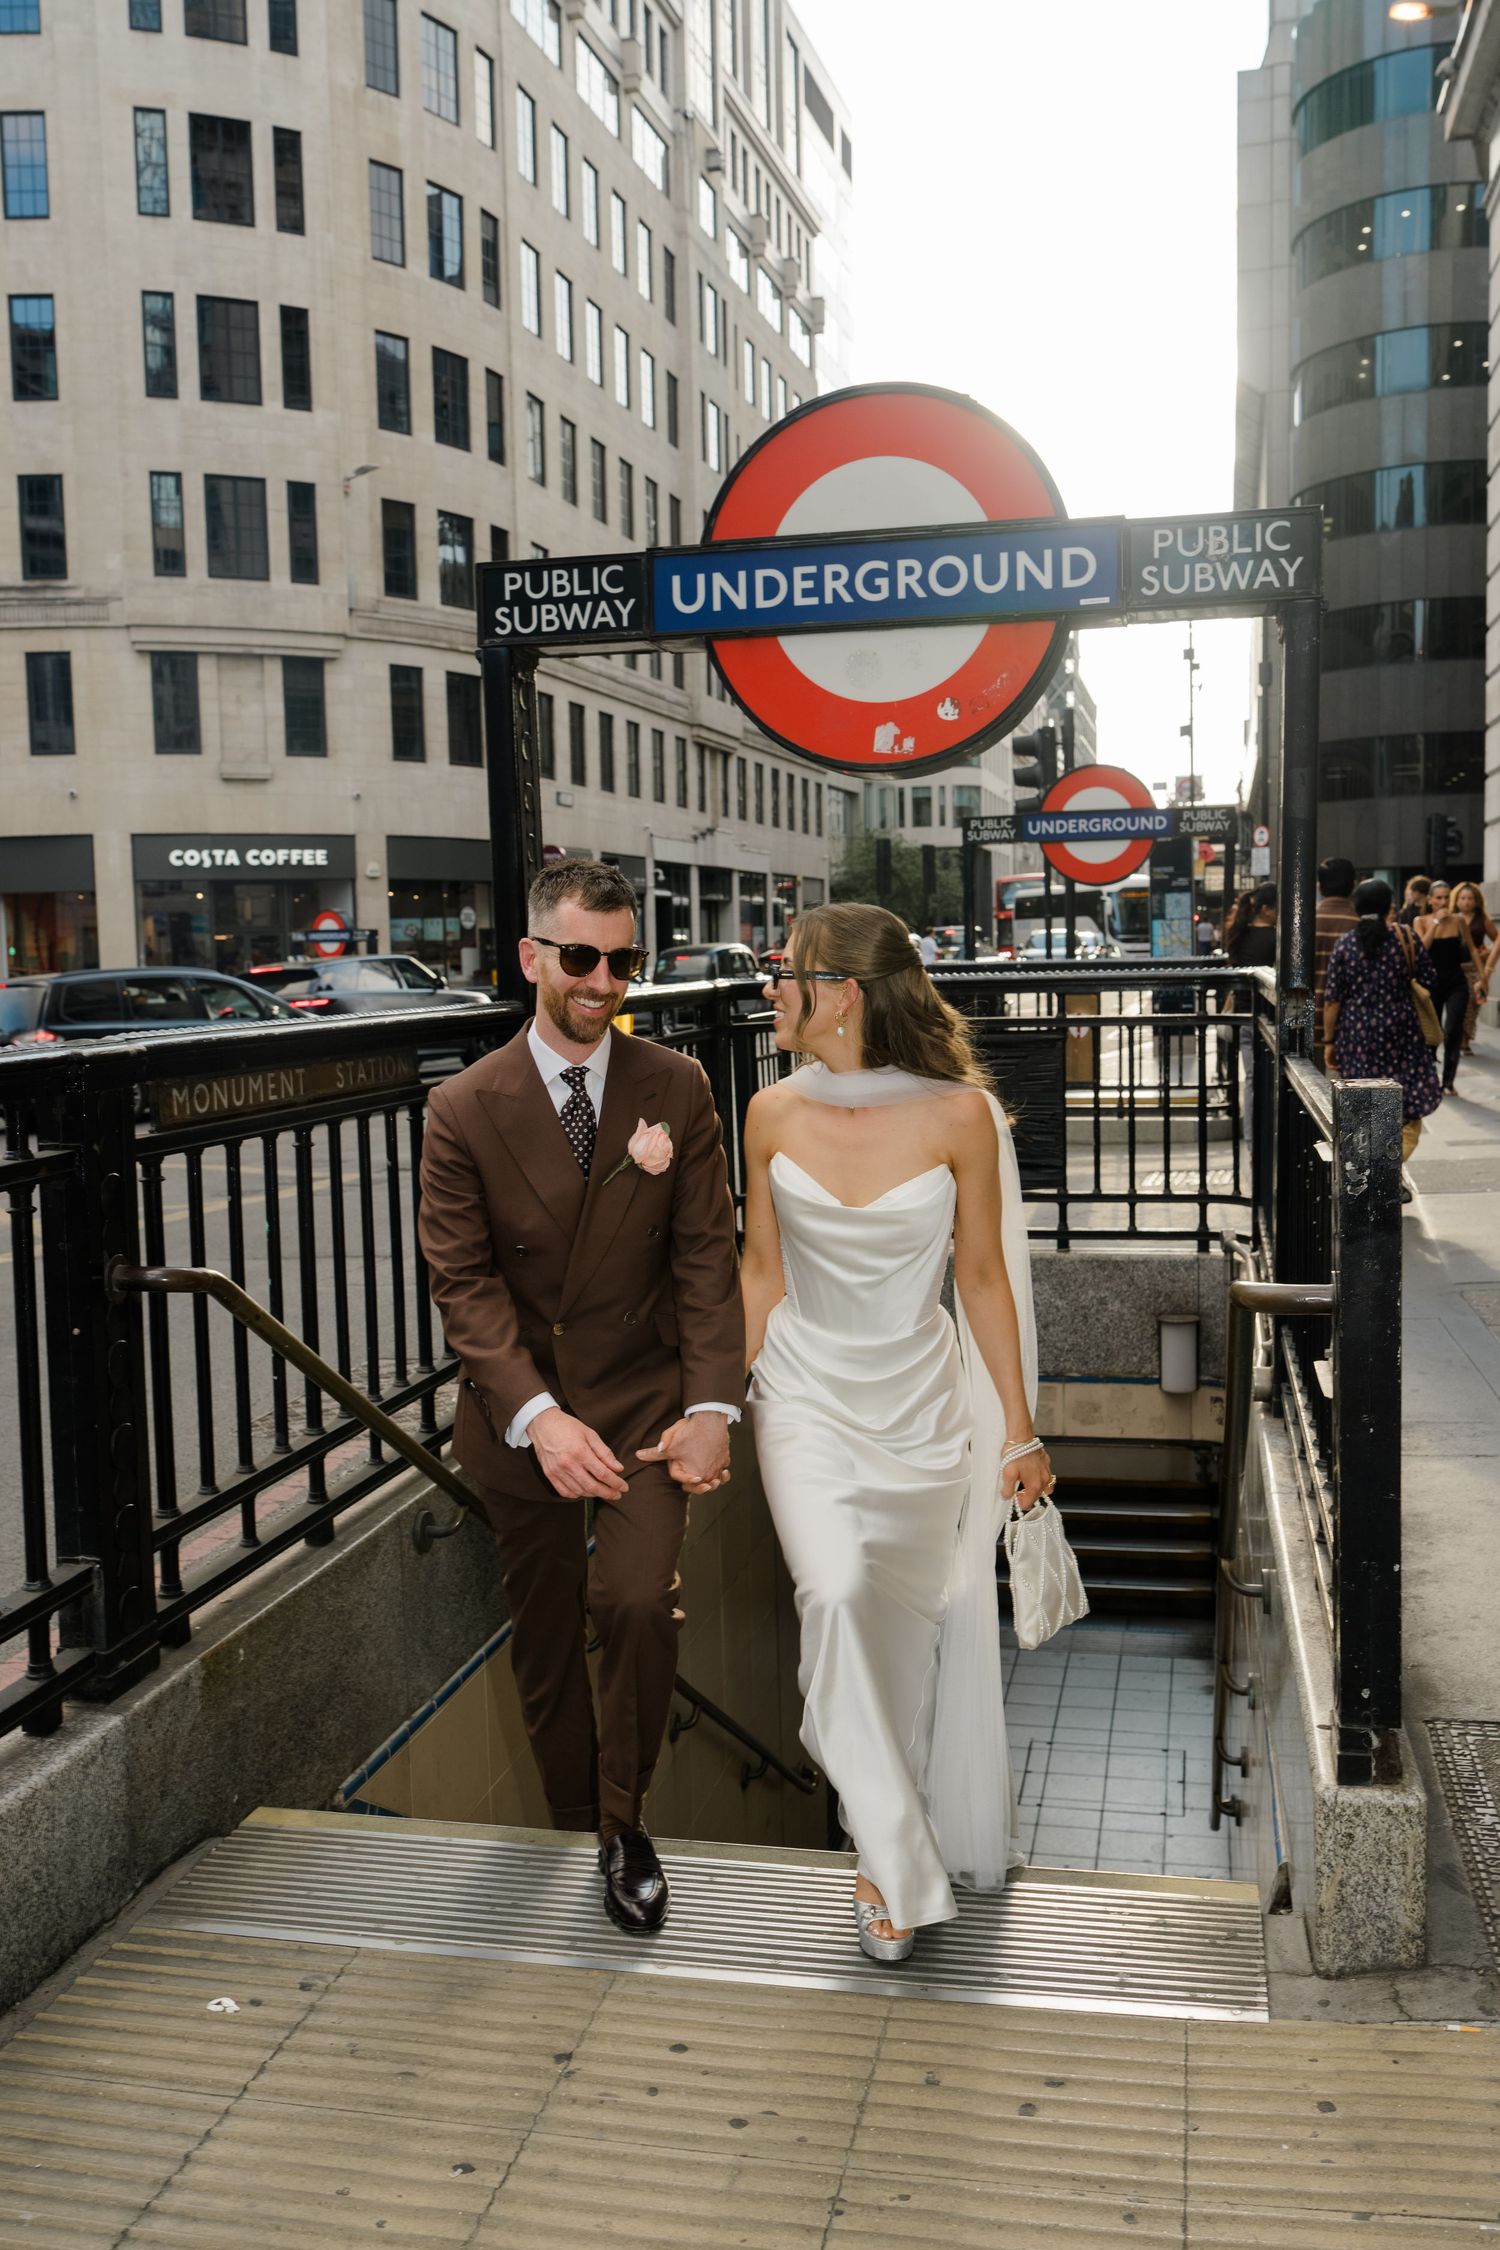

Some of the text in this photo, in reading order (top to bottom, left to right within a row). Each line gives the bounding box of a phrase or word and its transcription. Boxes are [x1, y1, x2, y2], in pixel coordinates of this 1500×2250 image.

[1153, 520, 1291, 559] PUBLIC
[504, 564, 624, 601] PUBLIC
[671, 546, 1097, 614] UNDERGROUND
[1140, 556, 1304, 596] SUBWAY
[494, 598, 636, 635] SUBWAY
[970, 818, 1012, 830] PUBLIC
[1027, 815, 1167, 835] UNDERGROUND
[1179, 818, 1231, 833] SUBWAY
[1182, 809, 1227, 821] PUBLIC
[967, 828, 1016, 841] SUBWAY
[168, 849, 328, 868] COSTA COFFEE
[172, 1055, 409, 1116] MONUMENT STATION
[1451, 1749, 1487, 1808] TELEPHONES
